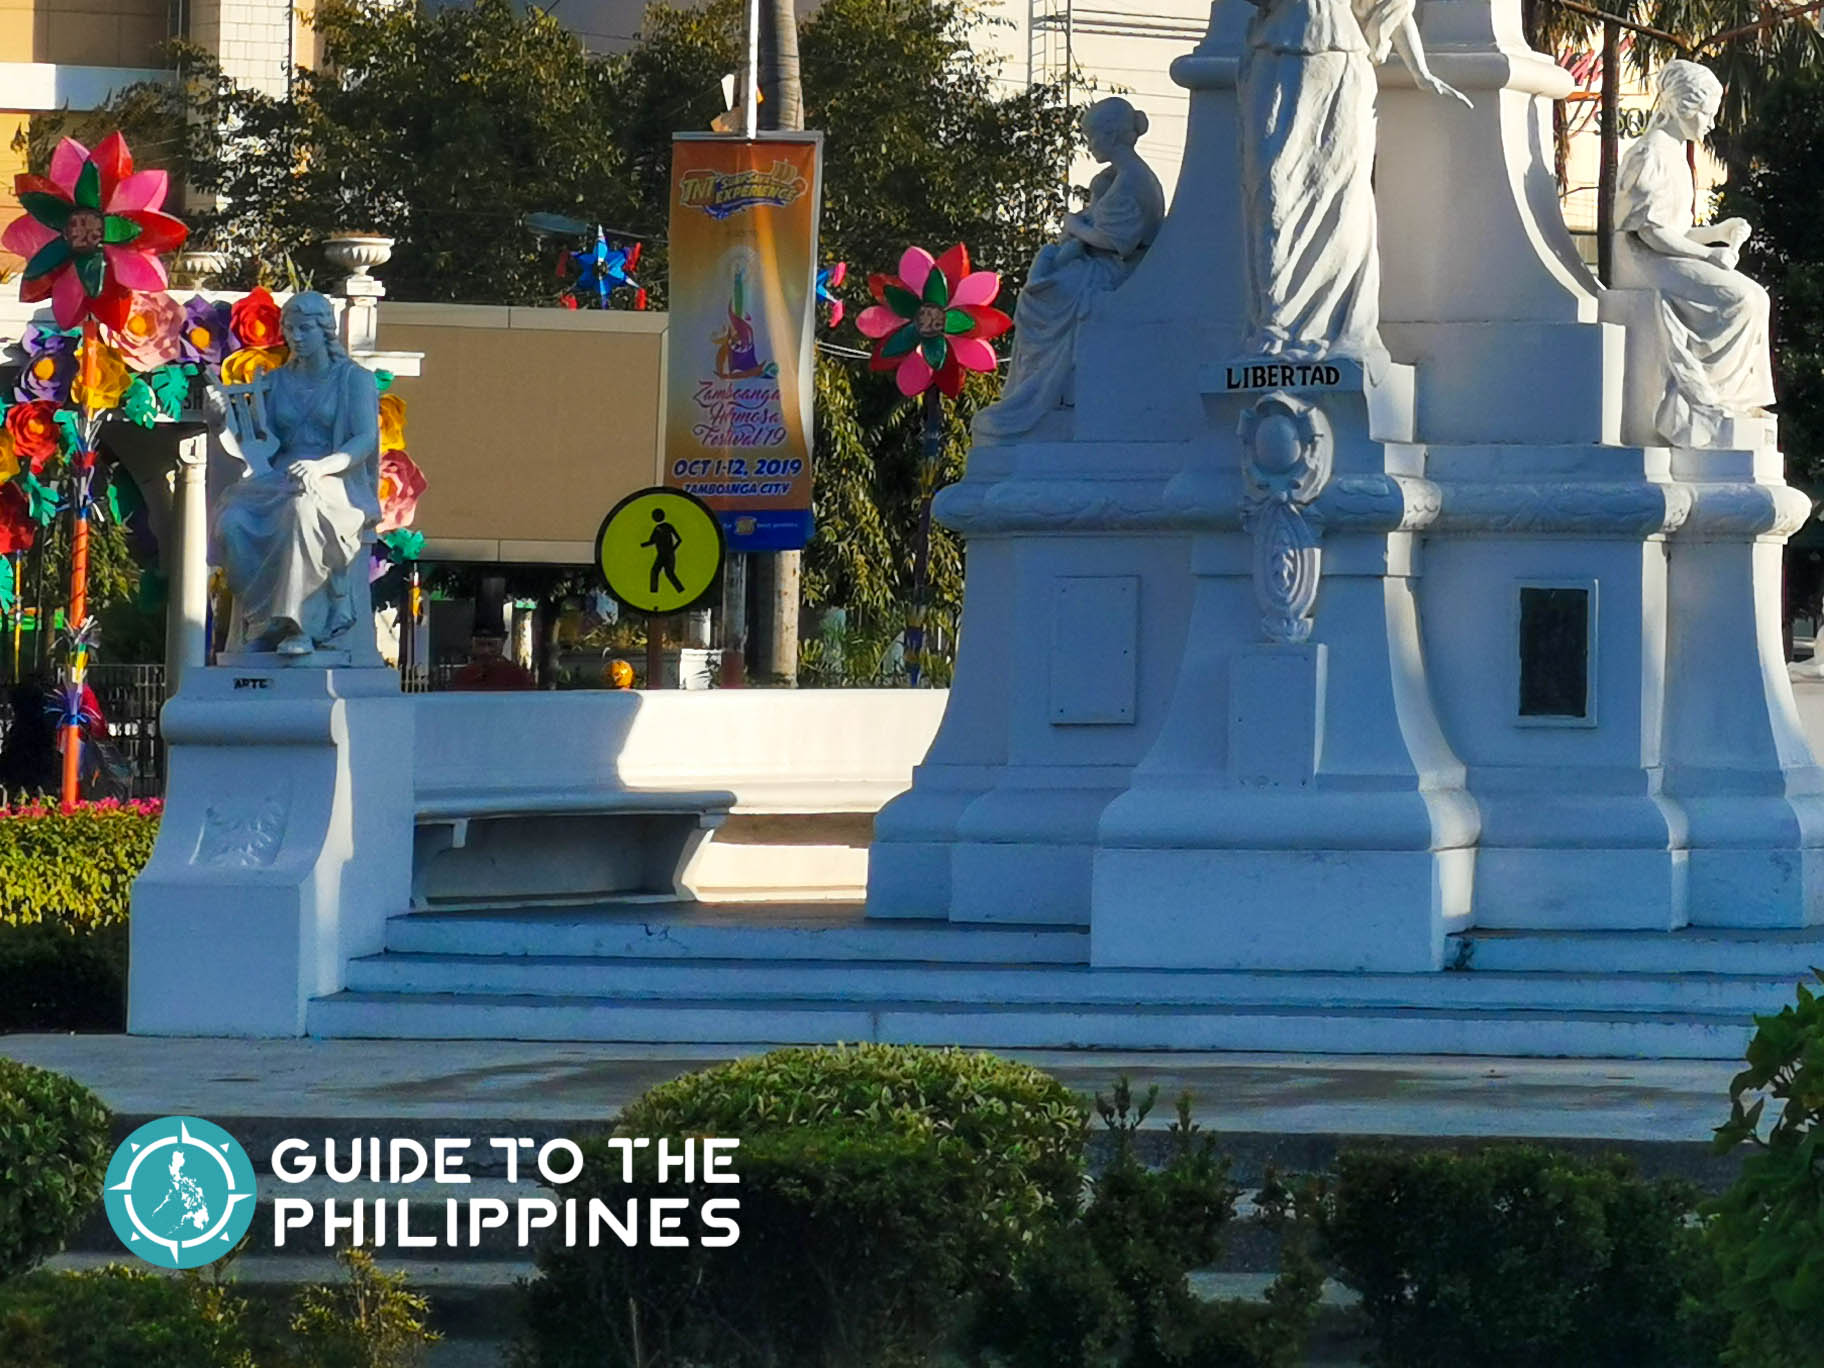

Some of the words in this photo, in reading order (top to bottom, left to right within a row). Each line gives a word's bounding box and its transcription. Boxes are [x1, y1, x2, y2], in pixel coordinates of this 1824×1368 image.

[1226, 364, 1341, 390] LIBERTAD
[692, 380, 782, 410] Zamboanga
[709, 401, 779, 427] Hermosa
[674, 458, 713, 476] OCT
[754, 458, 803, 476] 2019
[684, 483, 758, 495] ZAMBOANGA
[759, 483, 791, 494] CITY
